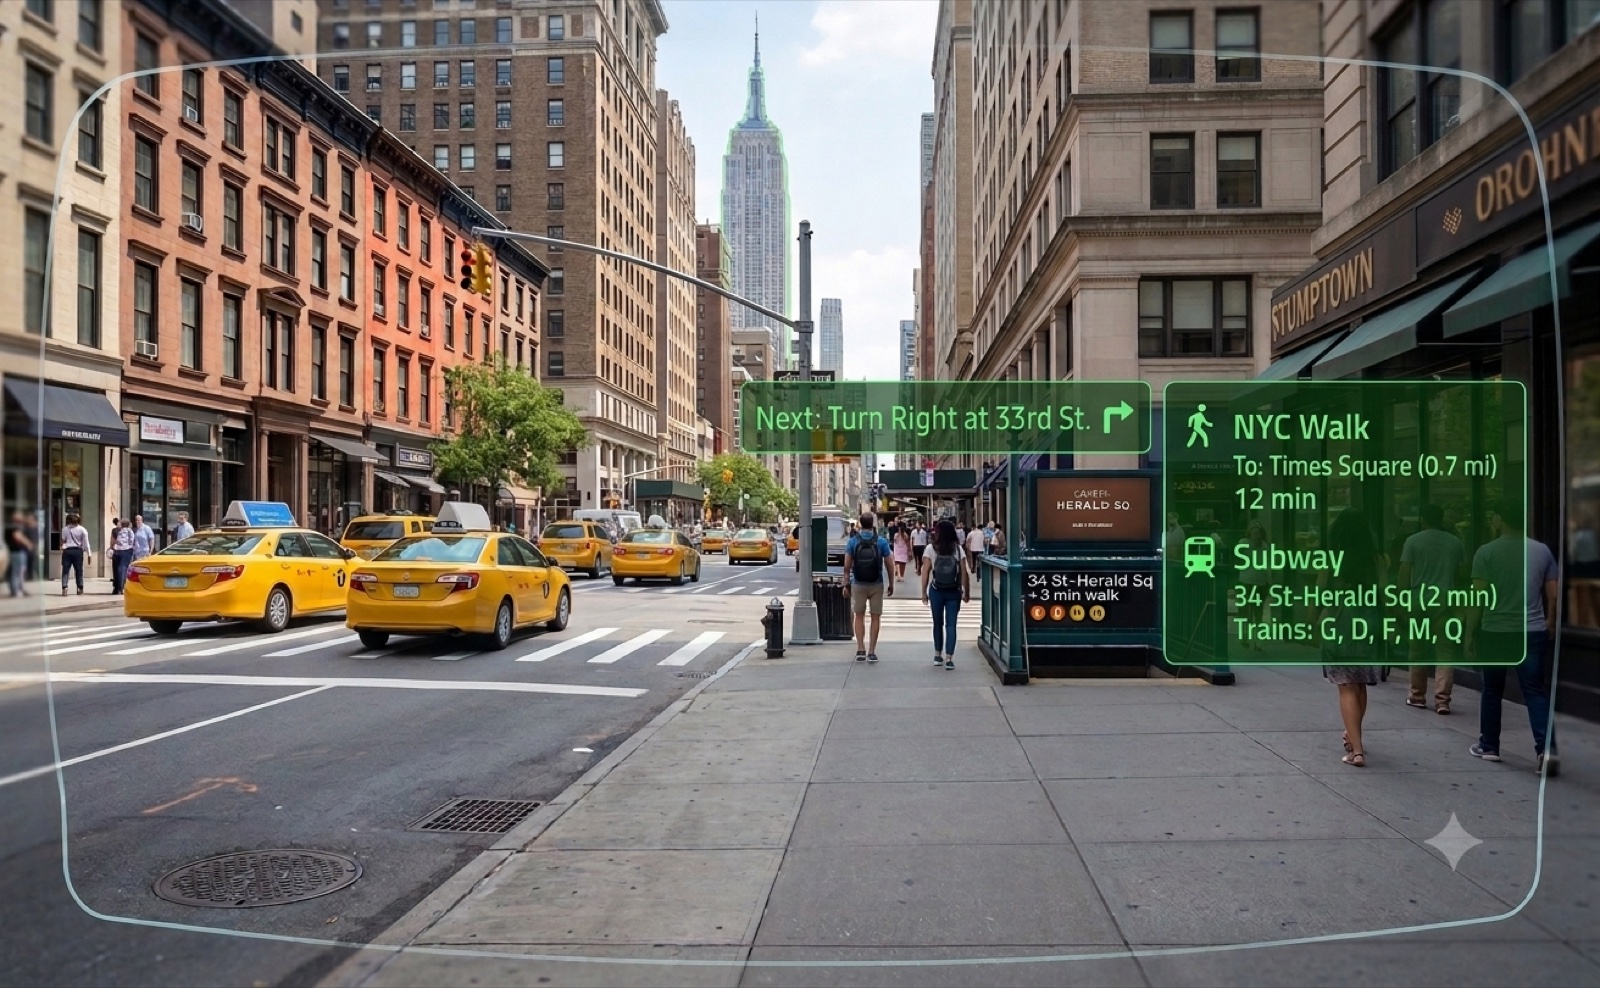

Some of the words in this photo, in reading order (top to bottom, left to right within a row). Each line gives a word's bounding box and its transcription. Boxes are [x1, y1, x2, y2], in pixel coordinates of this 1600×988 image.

[1271, 247, 1374, 342] STUMPTOWN
[1056, 500, 1111, 510] HERALD
[1027, 574, 1048, 587] 34
[1051, 573, 1128, 588] St-Herald
[1132, 573, 1154, 590] Sq
[1054, 588, 1081, 601] min
[1085, 588, 1119, 601] walk
